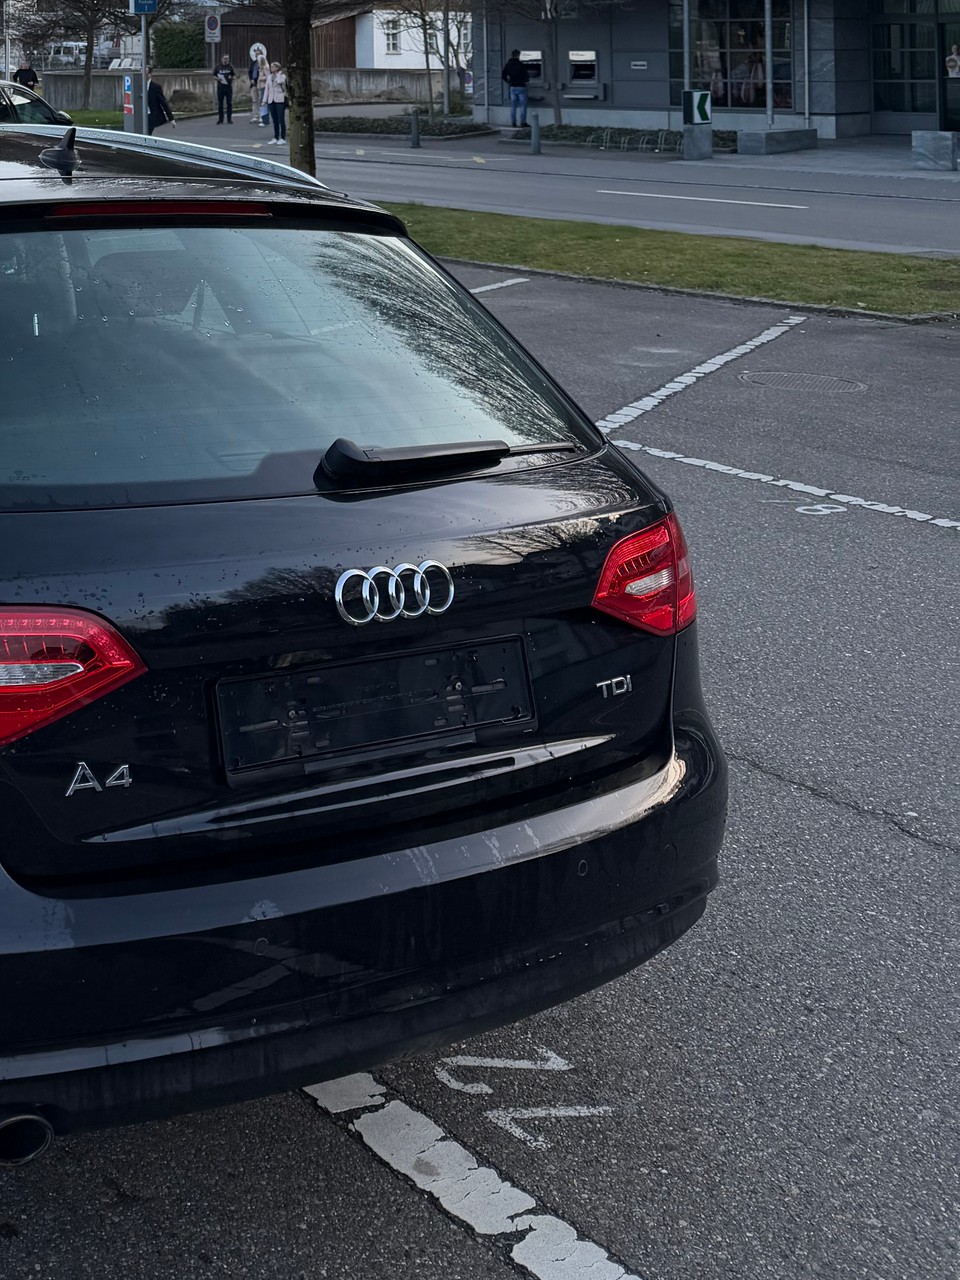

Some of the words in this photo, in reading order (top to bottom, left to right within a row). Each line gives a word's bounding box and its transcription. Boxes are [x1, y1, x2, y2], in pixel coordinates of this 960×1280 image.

[124, 75, 131, 91] P
[596, 674, 633, 699] TDI
[65, 761, 133, 797] A4
